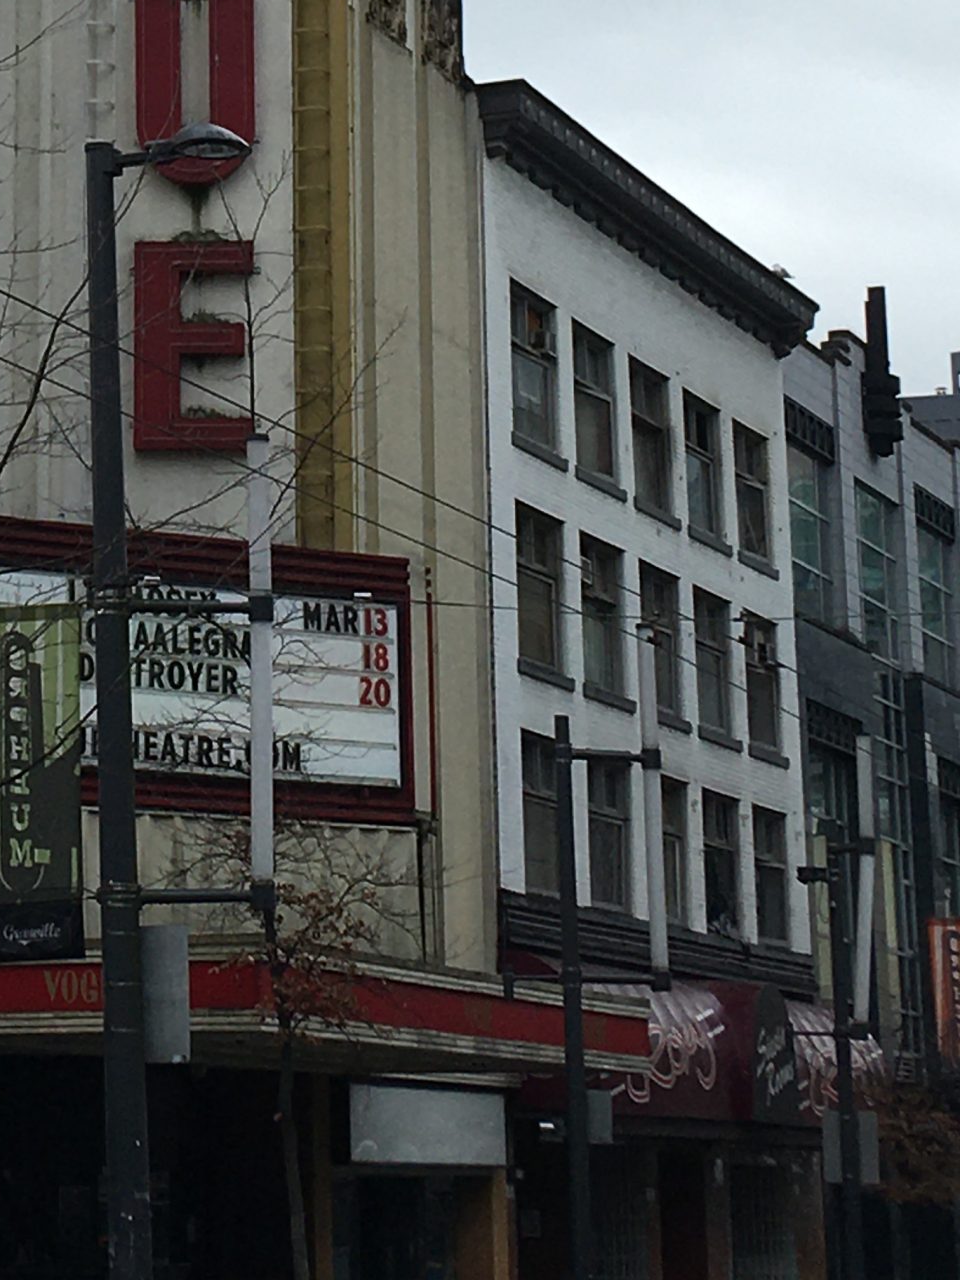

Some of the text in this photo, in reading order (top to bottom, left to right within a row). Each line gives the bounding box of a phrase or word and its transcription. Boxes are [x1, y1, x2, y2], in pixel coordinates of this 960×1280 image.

[303, 601, 359, 634] MAR
[363, 608, 389, 637] 13
[363, 643, 389, 672] 18
[80, 652, 392, 708] DTROYER 20
